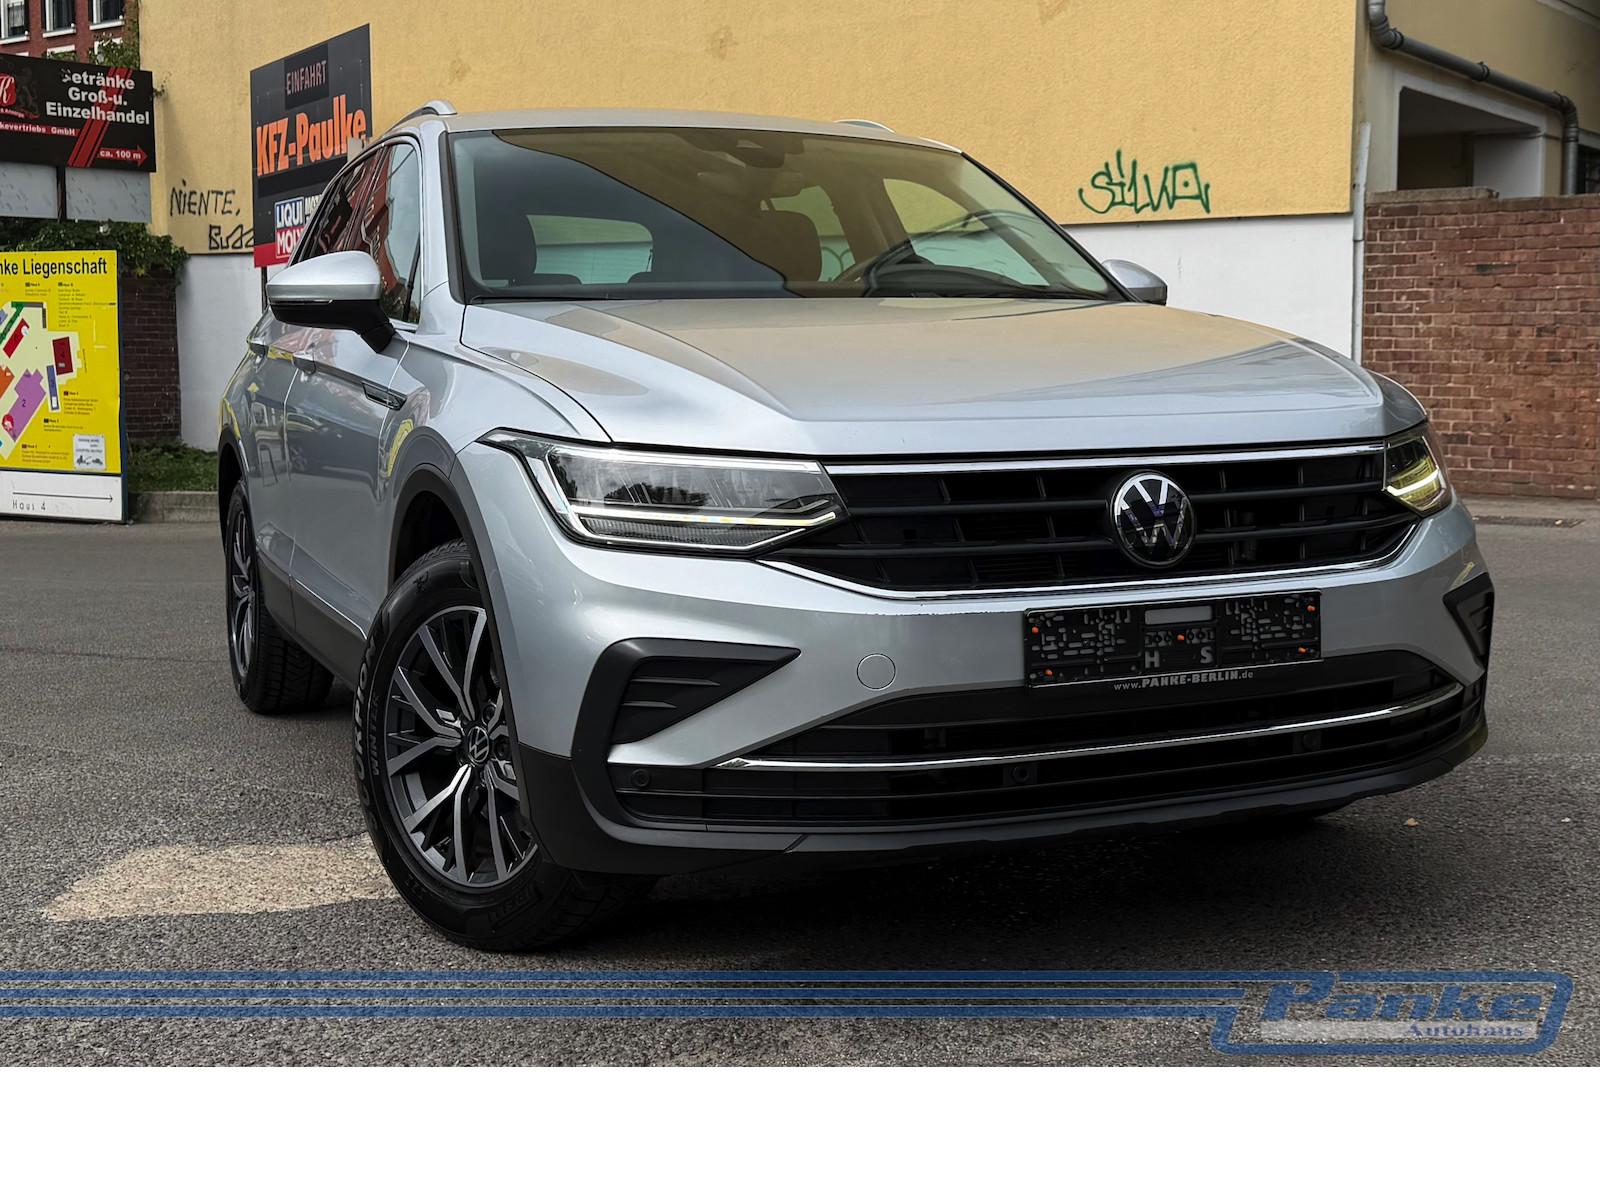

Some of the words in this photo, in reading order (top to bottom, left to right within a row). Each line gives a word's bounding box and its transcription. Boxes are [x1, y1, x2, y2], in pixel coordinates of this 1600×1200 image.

[286, 60, 327, 95] EINFAHRT
[46, 101, 150, 125] Einzelhandel
[51, 126, 76, 136] GmbH
[256, 94, 366, 176] KFZ-Paulke
[100, 150, 114, 158] ca.
[116, 150, 132, 159] 100
[276, 200, 303, 228] LIQUI
[23, 257, 108, 279] Liegenschaft
[1113, 670, 1254, 691] www.PANKE-BERLIN.de
